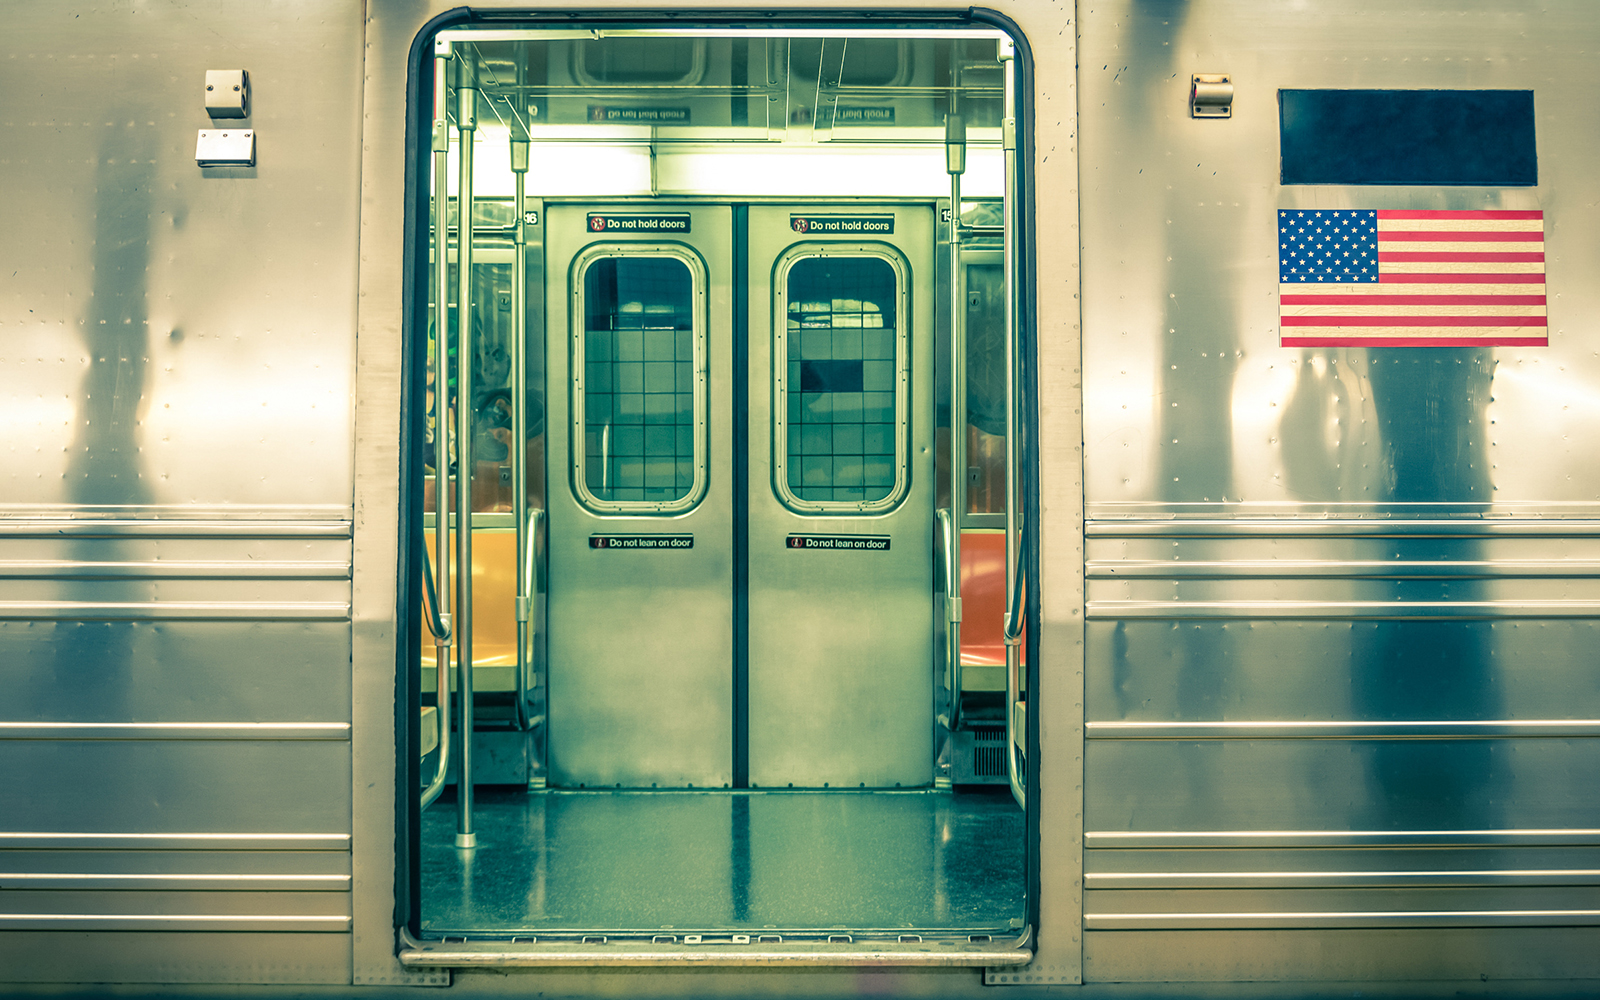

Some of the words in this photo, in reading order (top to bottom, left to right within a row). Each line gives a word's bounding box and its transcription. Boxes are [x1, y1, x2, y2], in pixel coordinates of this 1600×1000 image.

[525, 212, 538, 224] 16
[607, 219, 620, 228] Do
[621, 219, 637, 228] not
[638, 219, 658, 228] hold
[659, 219, 686, 228] doors
[810, 221, 823, 230] Do
[825, 221, 840, 230] not
[841, 221, 861, 230] hold
[863, 221, 890, 230] doors
[609, 538, 622, 547] Do
[623, 538, 638, 547] not
[639, 538, 657, 547] lean
[670, 538, 691, 547] door
[805, 538, 819, 547] Do
[819, 539, 834, 548] not
[835, 539, 853, 548] lean
[866, 540, 887, 549] door
